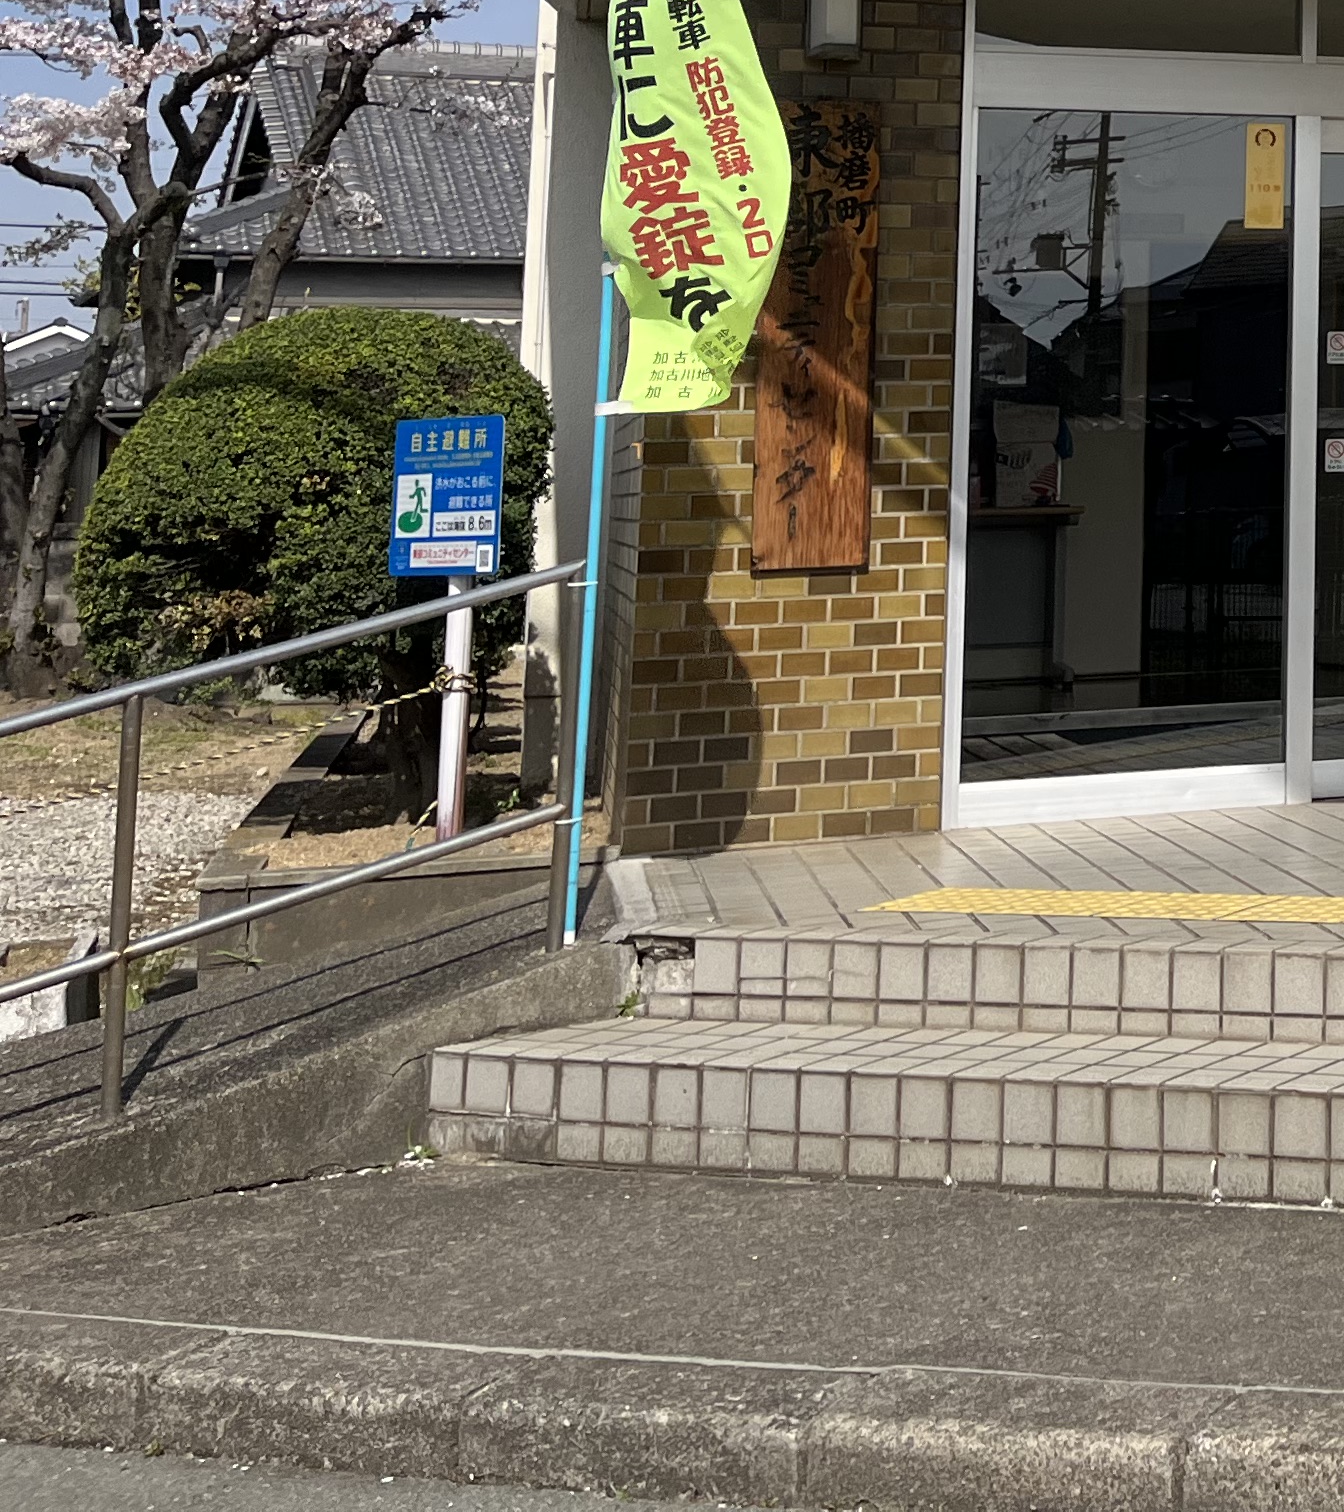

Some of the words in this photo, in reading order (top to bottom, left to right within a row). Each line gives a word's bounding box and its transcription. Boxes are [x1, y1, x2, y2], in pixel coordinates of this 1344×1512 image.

[832, 112, 876, 236] 播磨町
[410, 428, 488, 453] 自主避難所
